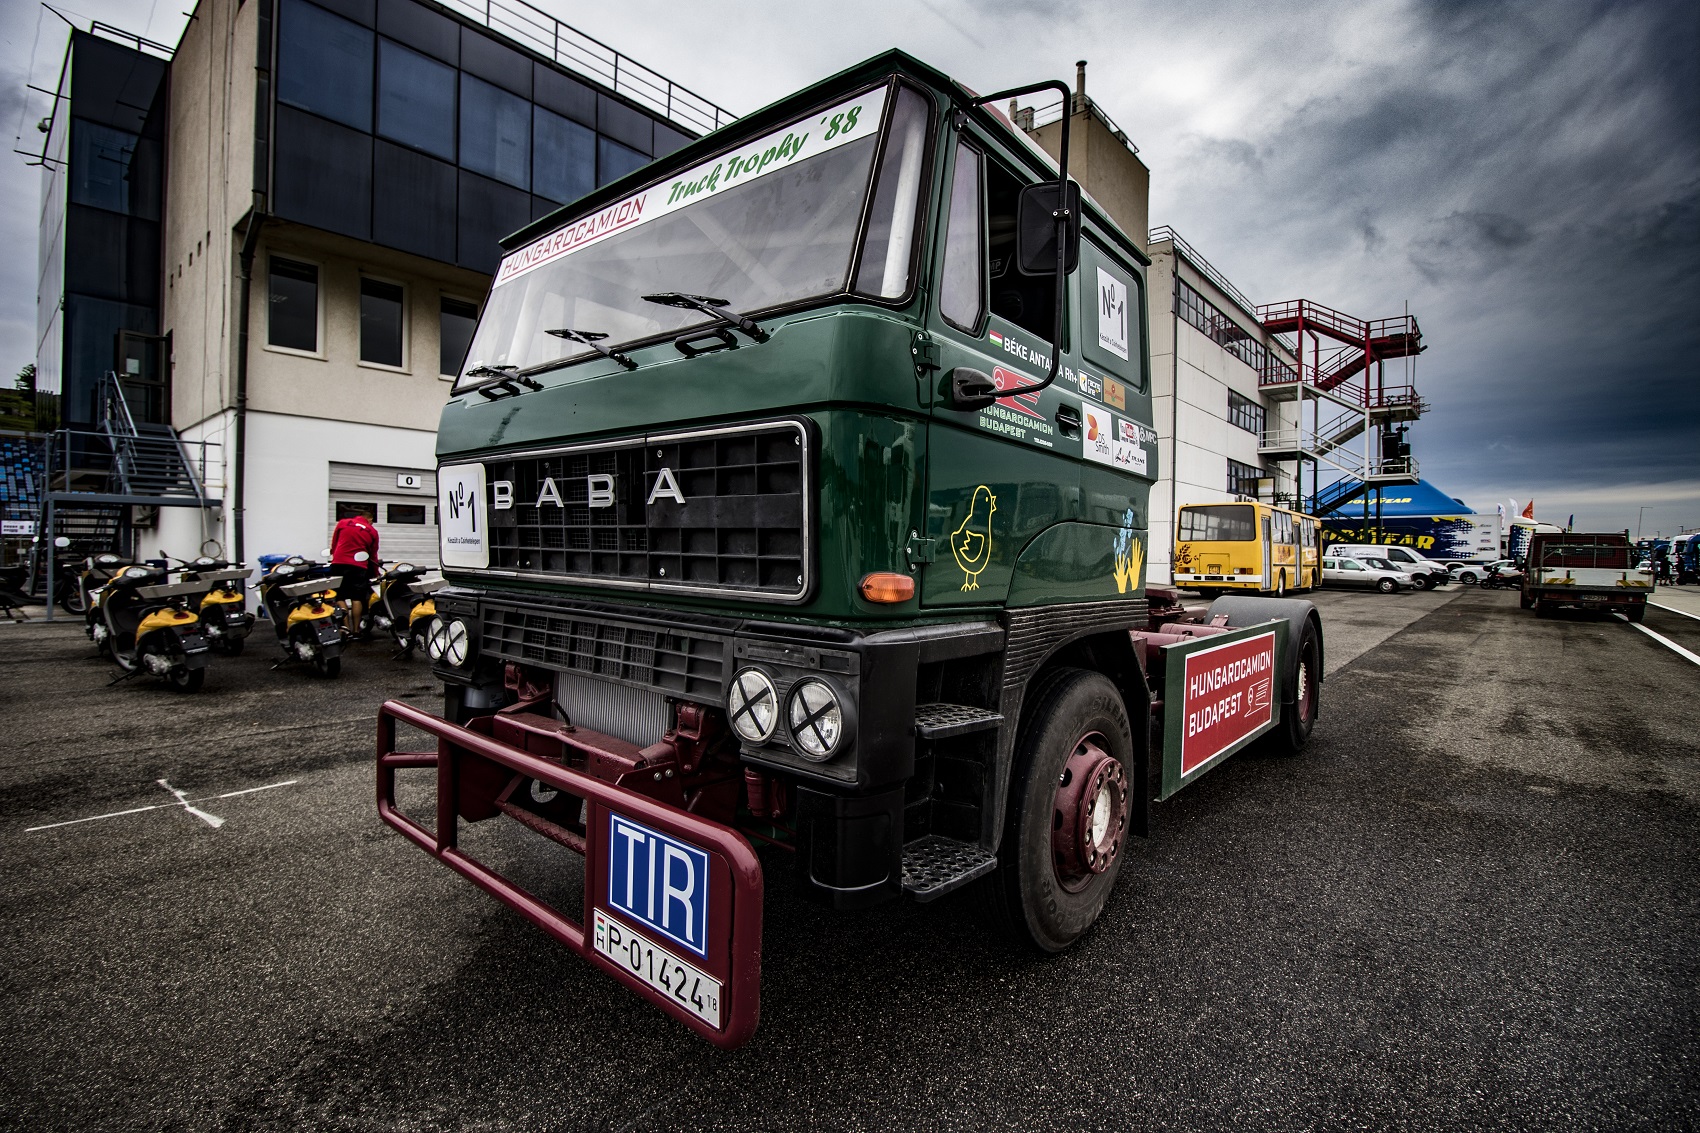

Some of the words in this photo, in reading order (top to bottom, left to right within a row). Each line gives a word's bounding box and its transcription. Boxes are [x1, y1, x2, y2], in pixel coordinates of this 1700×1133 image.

[502, 194, 647, 277] HUNGAROCAMION
[667, 163, 723, 205] Truck
[724, 132, 809, 182] Trophy
[1004, 337, 1028, 361] BÉKE
[1065, 367, 1078, 384] Rh+
[980, 416, 1026, 439] BUDAPEST
[493, 467, 686, 510] BABA
[1190, 649, 1271, 700] HUNGAROCAMION
[1188, 691, 1242, 738] BUDAPEST
[618, 823, 694, 942] TIR
[596, 931, 605, 949] H
[608, 925, 704, 1013] P-01424
